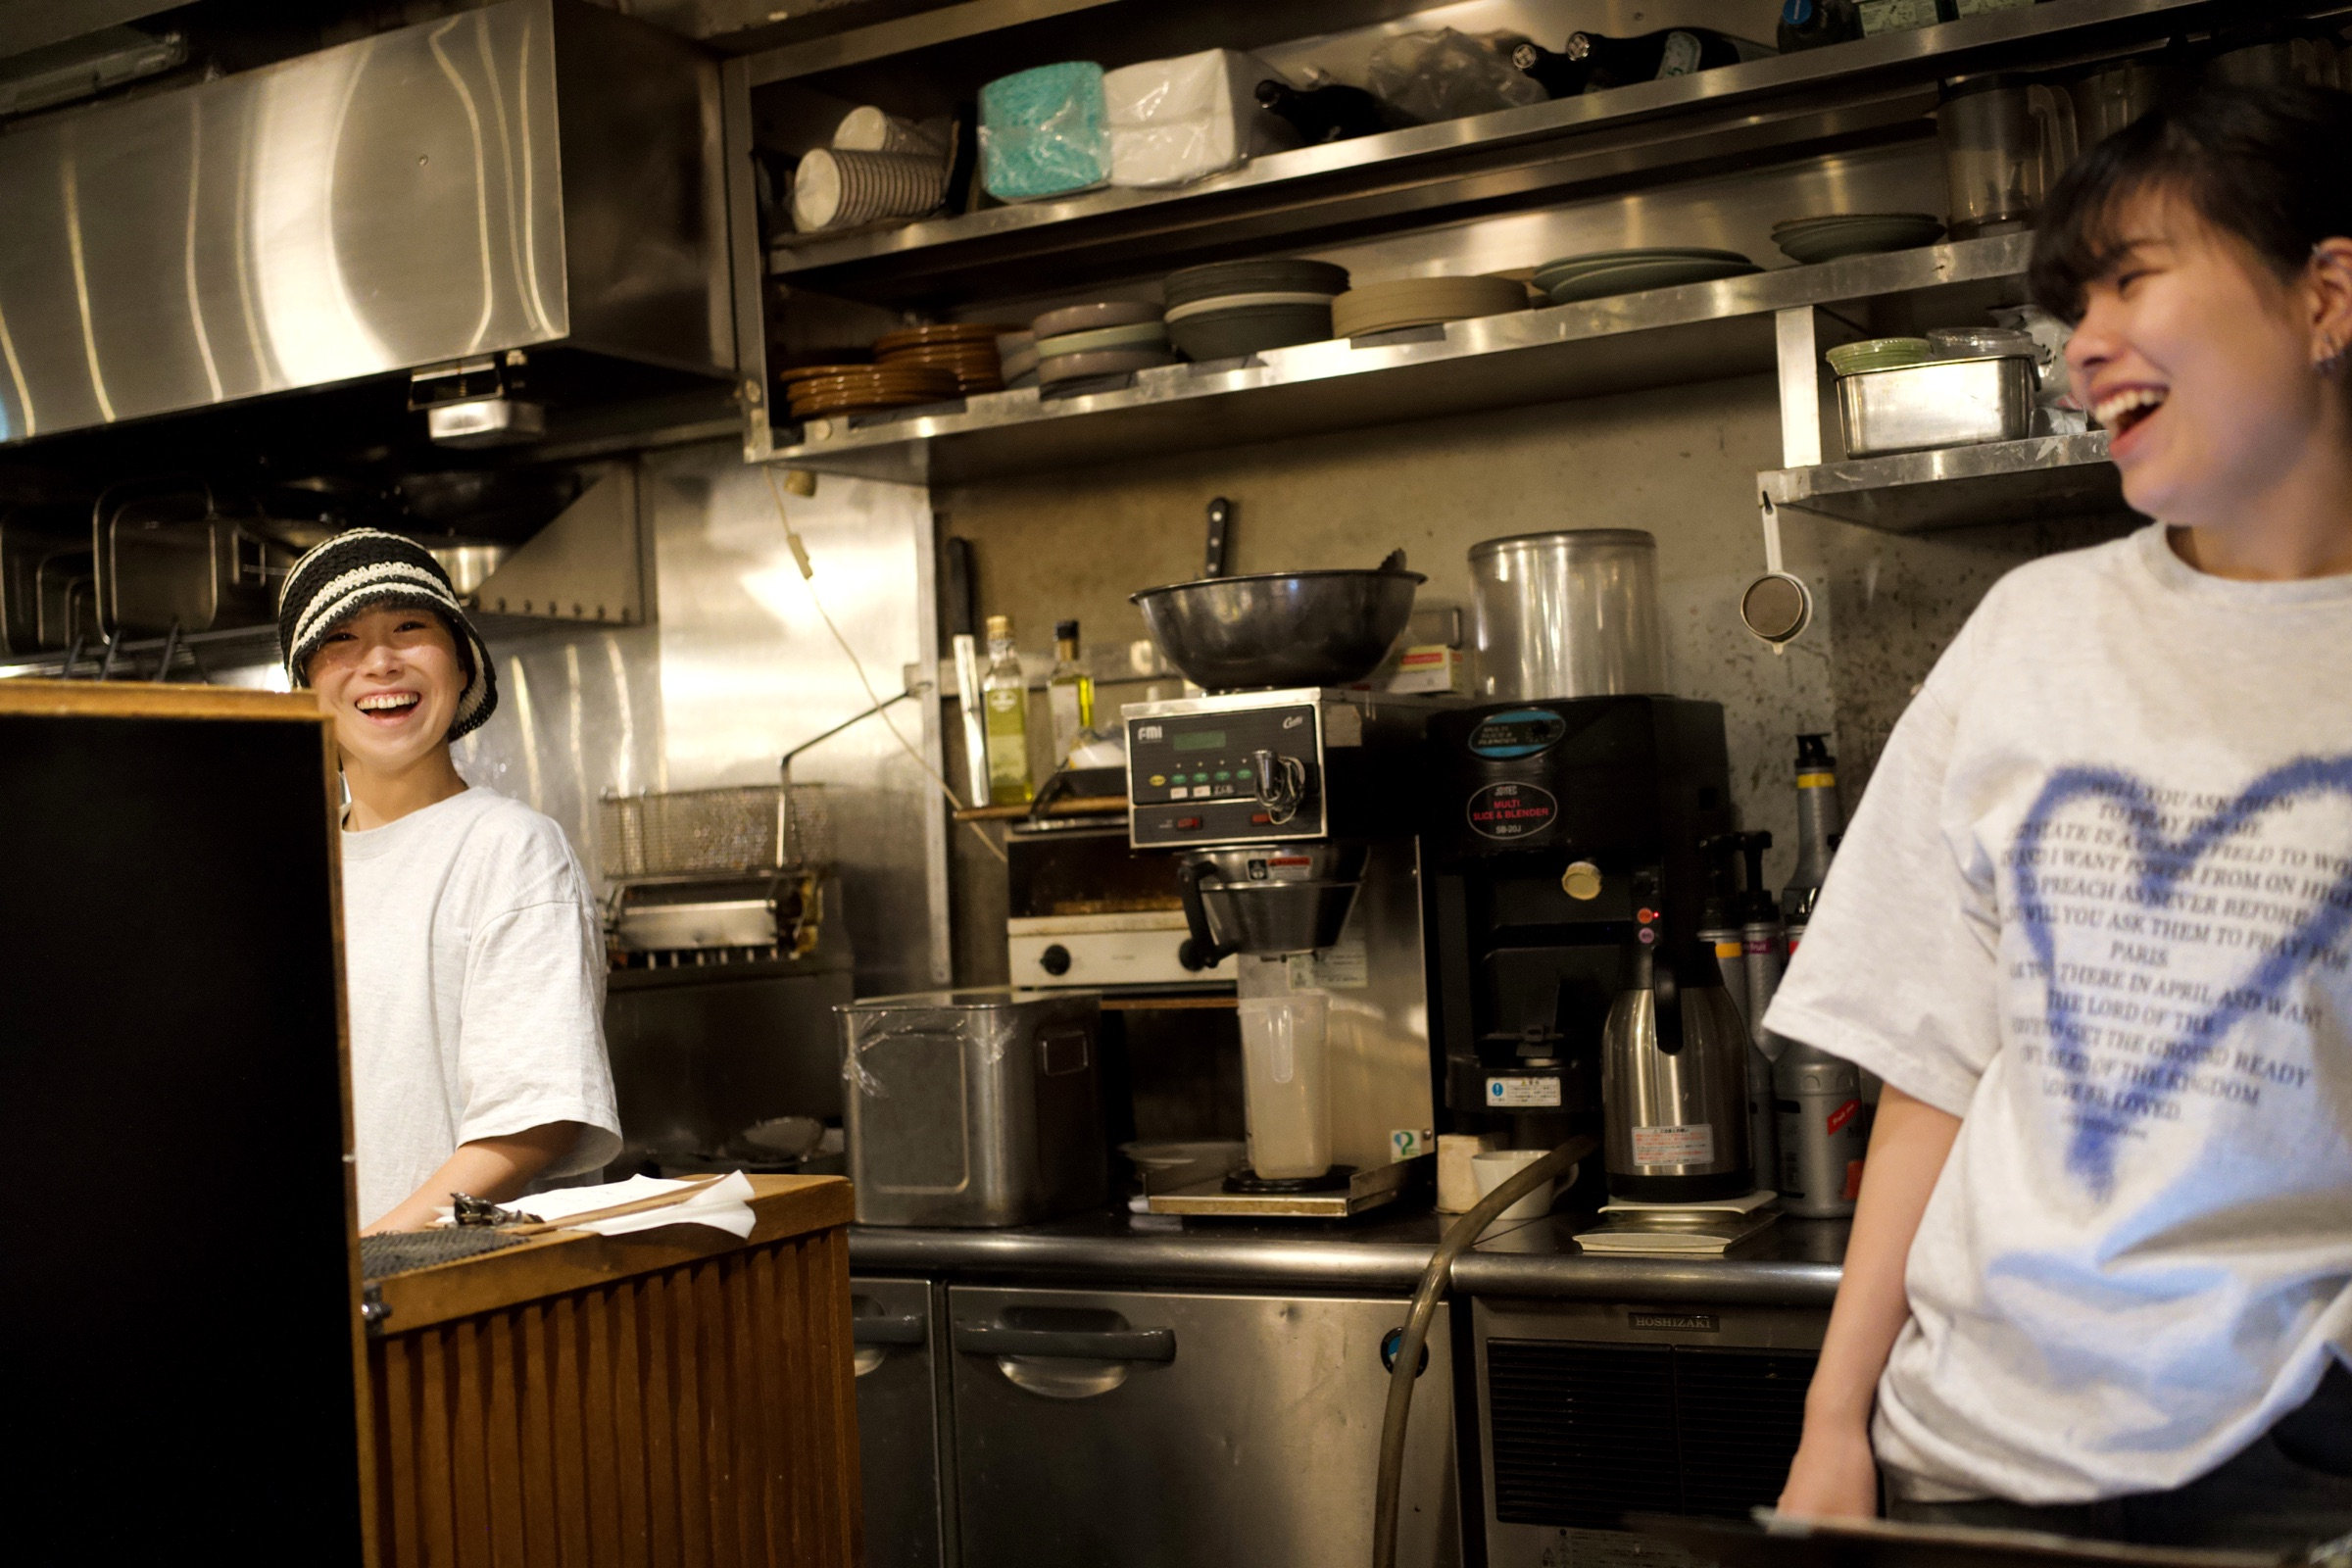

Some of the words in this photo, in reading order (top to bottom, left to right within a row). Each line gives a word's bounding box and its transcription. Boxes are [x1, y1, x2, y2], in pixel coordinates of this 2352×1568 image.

[1138, 726, 1163, 741] FMI
[1494, 799, 1521, 809] MULTI
[1496, 809, 1504, 820] &
[1504, 807, 1550, 820] BLENDER
[2062, 848, 2121, 873] WANT
[2200, 867, 2263, 891] FROM
[2265, 872, 2296, 895] ON
[2039, 876, 2117, 902] PREACH
[2062, 904, 2106, 928] YOU
[2106, 910, 2144, 935] ASK
[2150, 916, 2211, 944] THEM
[2216, 925, 2243, 945] TO
[2107, 940, 2169, 968] PARIS
[2058, 961, 2126, 989] THERE
[2128, 973, 2152, 994] IN
[2047, 989, 2082, 1013] THE
[2086, 996, 2139, 1021] LORD
[2141, 1005, 2168, 1026] OF
[2106, 1029, 2145, 1053] THE
[2232, 1048, 2312, 1091] READY
[1636, 1315, 1711, 1329] HOSHIZAKI
